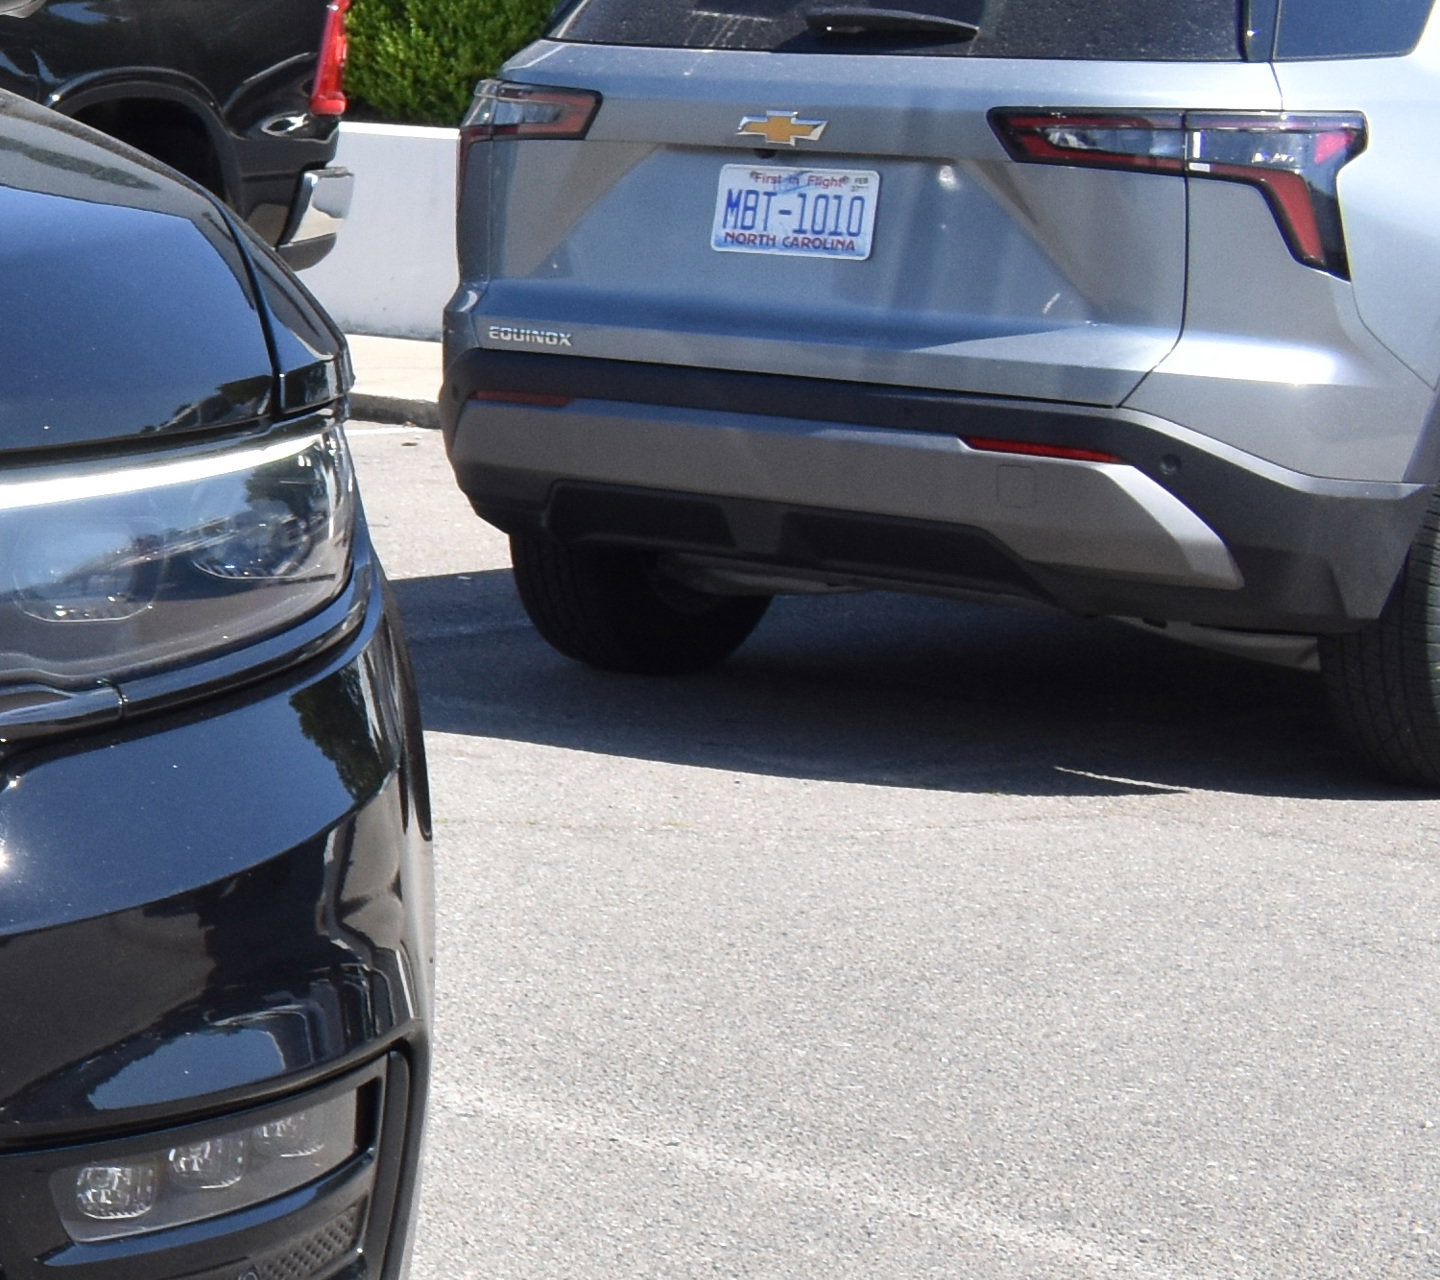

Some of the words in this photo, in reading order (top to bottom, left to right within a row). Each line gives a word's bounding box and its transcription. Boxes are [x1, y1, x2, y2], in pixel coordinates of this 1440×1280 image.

[807, 174, 844, 190] Flight
[722, 188, 866, 238] MBT-1010
[724, 232, 777, 248] NORTH
[782, 235, 856, 252] CAROLINA
[488, 325, 572, 347] EQUINOX
